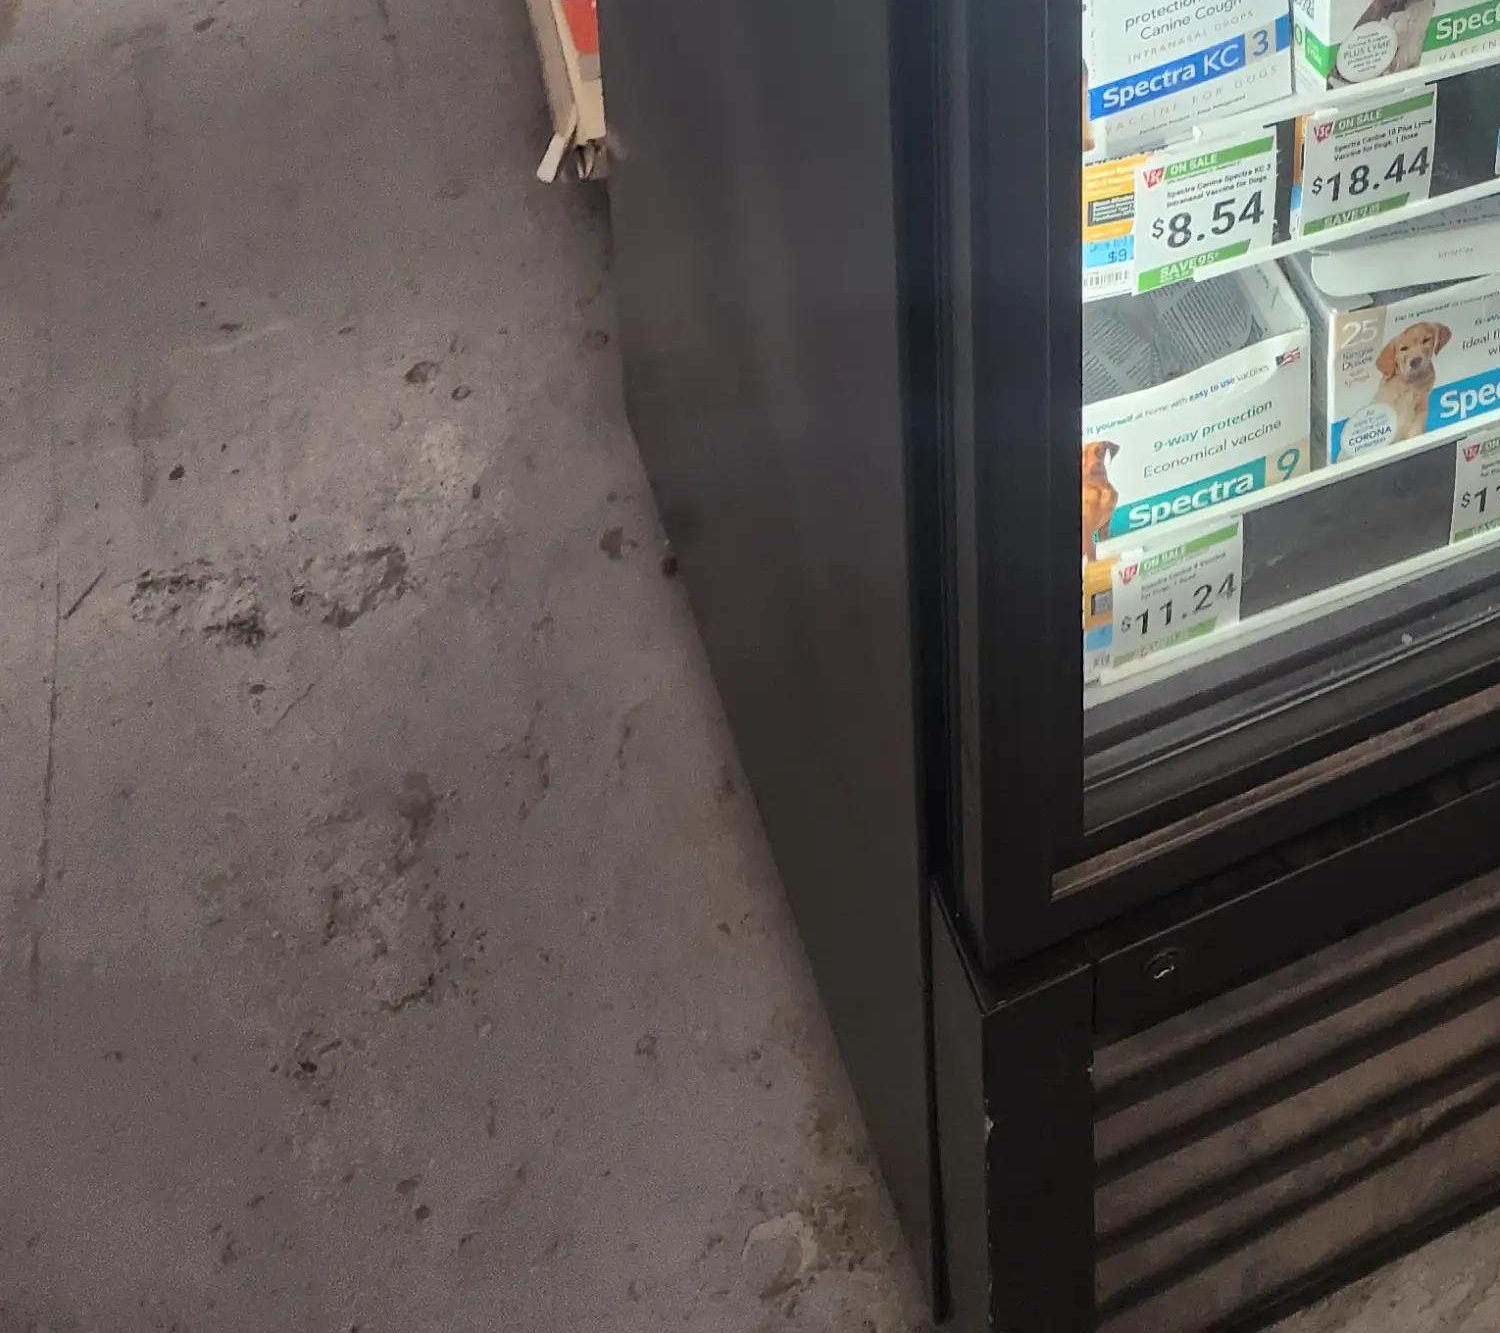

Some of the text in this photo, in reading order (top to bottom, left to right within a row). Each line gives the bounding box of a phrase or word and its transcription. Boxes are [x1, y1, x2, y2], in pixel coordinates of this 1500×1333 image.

[1140, 15, 1191, 40] Canine
[1103, 44, 1240, 109] Spectra KC
[1312, 146, 1429, 202] $18.44
[1152, 190, 1265, 248] $8.54
[1462, 330, 1491, 350] Ideal
[1143, 419, 1282, 479] Economical vaccine
[1153, 399, 1274, 452] 9-way protection
[1348, 425, 1393, 445] CORONA
[1127, 471, 1255, 530] Spectra
[1120, 572, 1236, 636] $11.24
